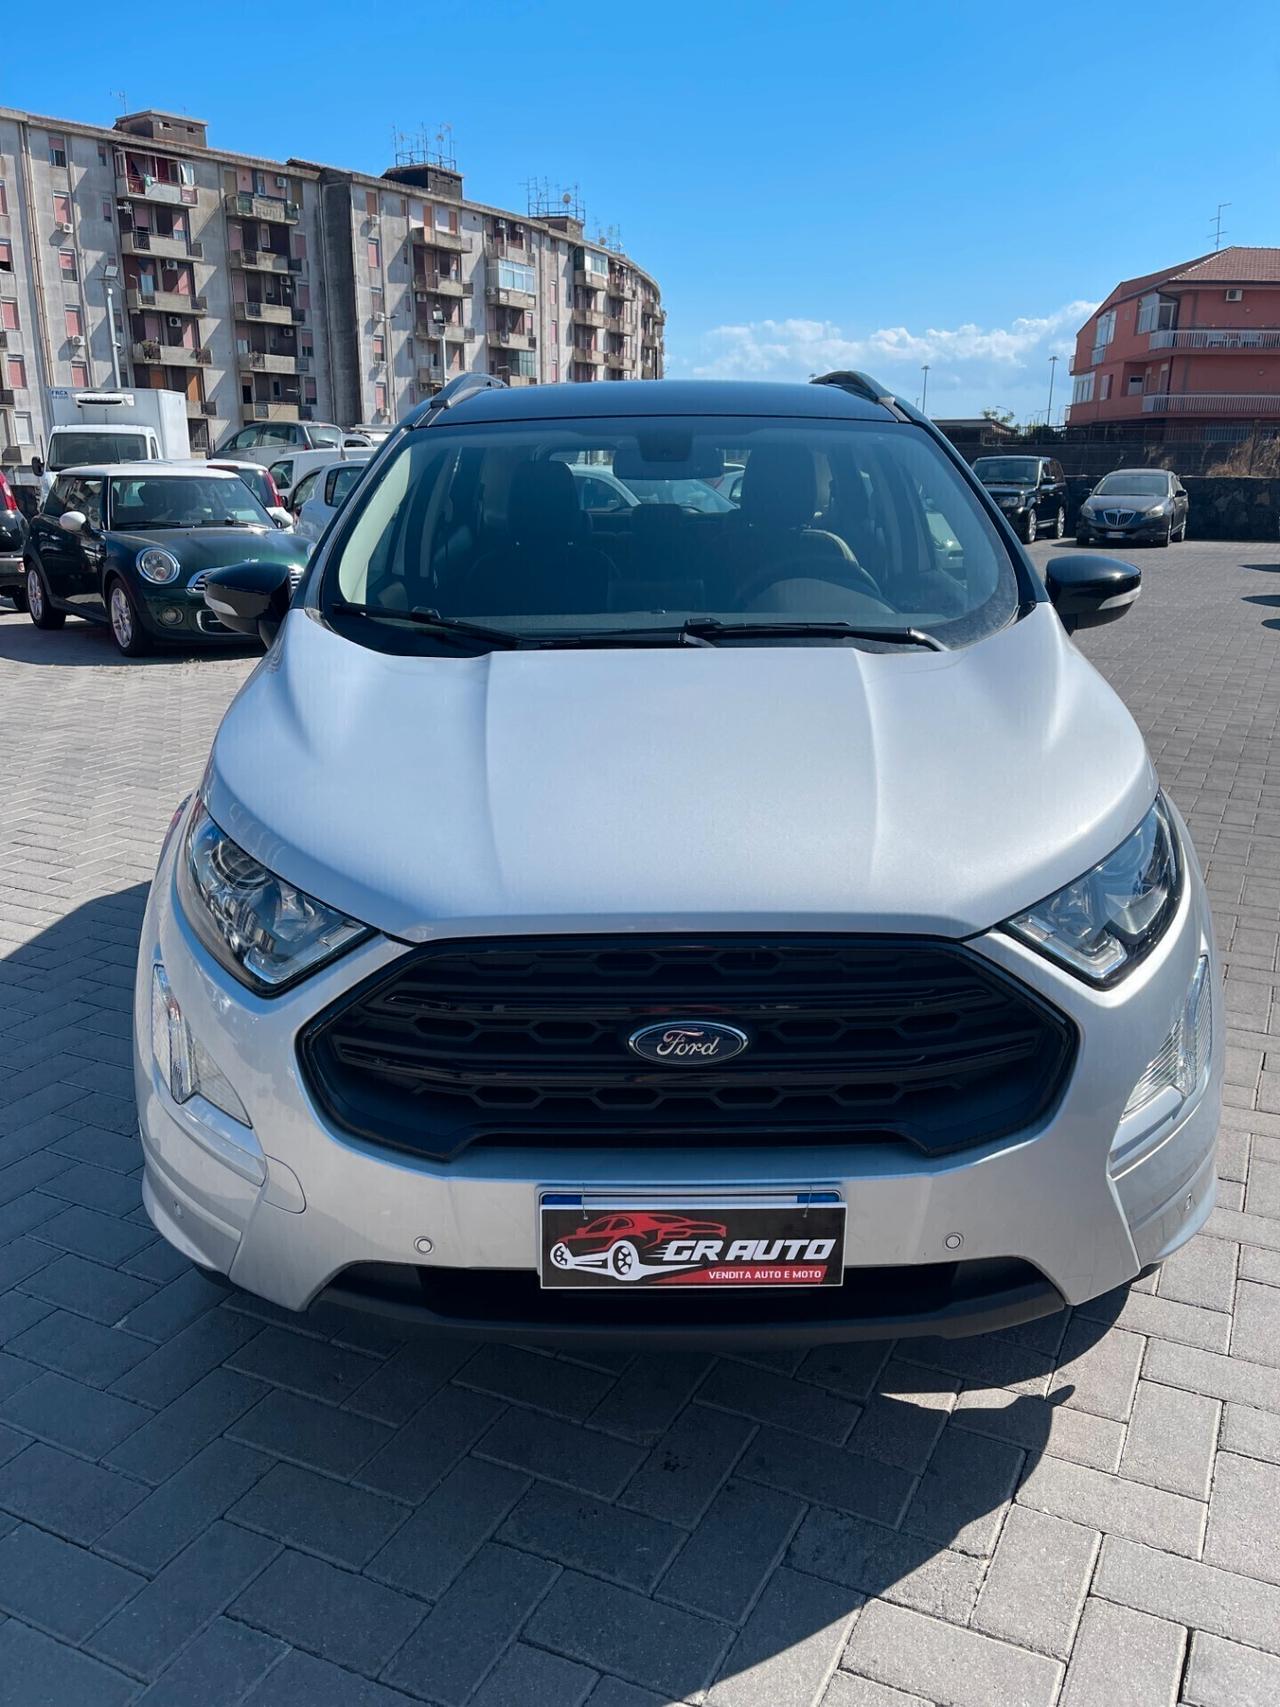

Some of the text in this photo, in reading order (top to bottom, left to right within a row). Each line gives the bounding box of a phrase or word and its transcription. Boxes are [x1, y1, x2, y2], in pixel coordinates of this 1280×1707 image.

[656, 1029, 721, 1055] Ford
[662, 1239, 837, 1261] GR AUTO
[708, 1269, 822, 1279] VENDITA AUTO E MOTO
